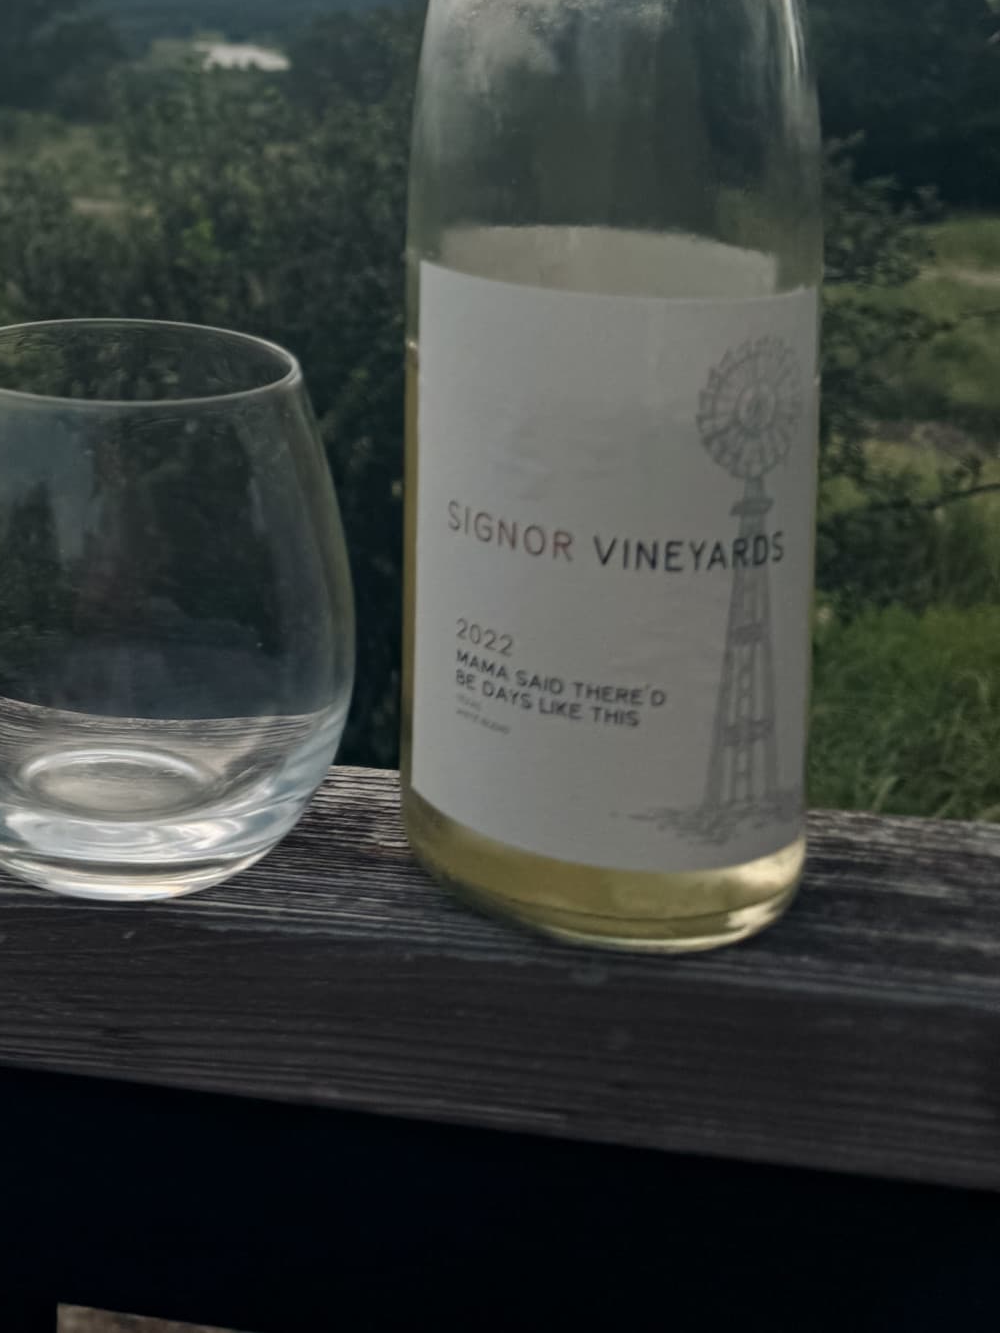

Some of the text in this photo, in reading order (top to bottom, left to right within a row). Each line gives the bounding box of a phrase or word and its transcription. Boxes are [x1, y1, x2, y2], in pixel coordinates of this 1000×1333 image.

[448, 500, 785, 572] SIGNOR VINEYARDS
[456, 617, 513, 656] 2022
[456, 650, 508, 680] MAMA
[515, 670, 565, 695] SAID
[456, 670, 475, 690] BE
[482, 681, 532, 710] DAYS
[538, 697, 583, 720] LIKE
[590, 706, 640, 727] THIS
